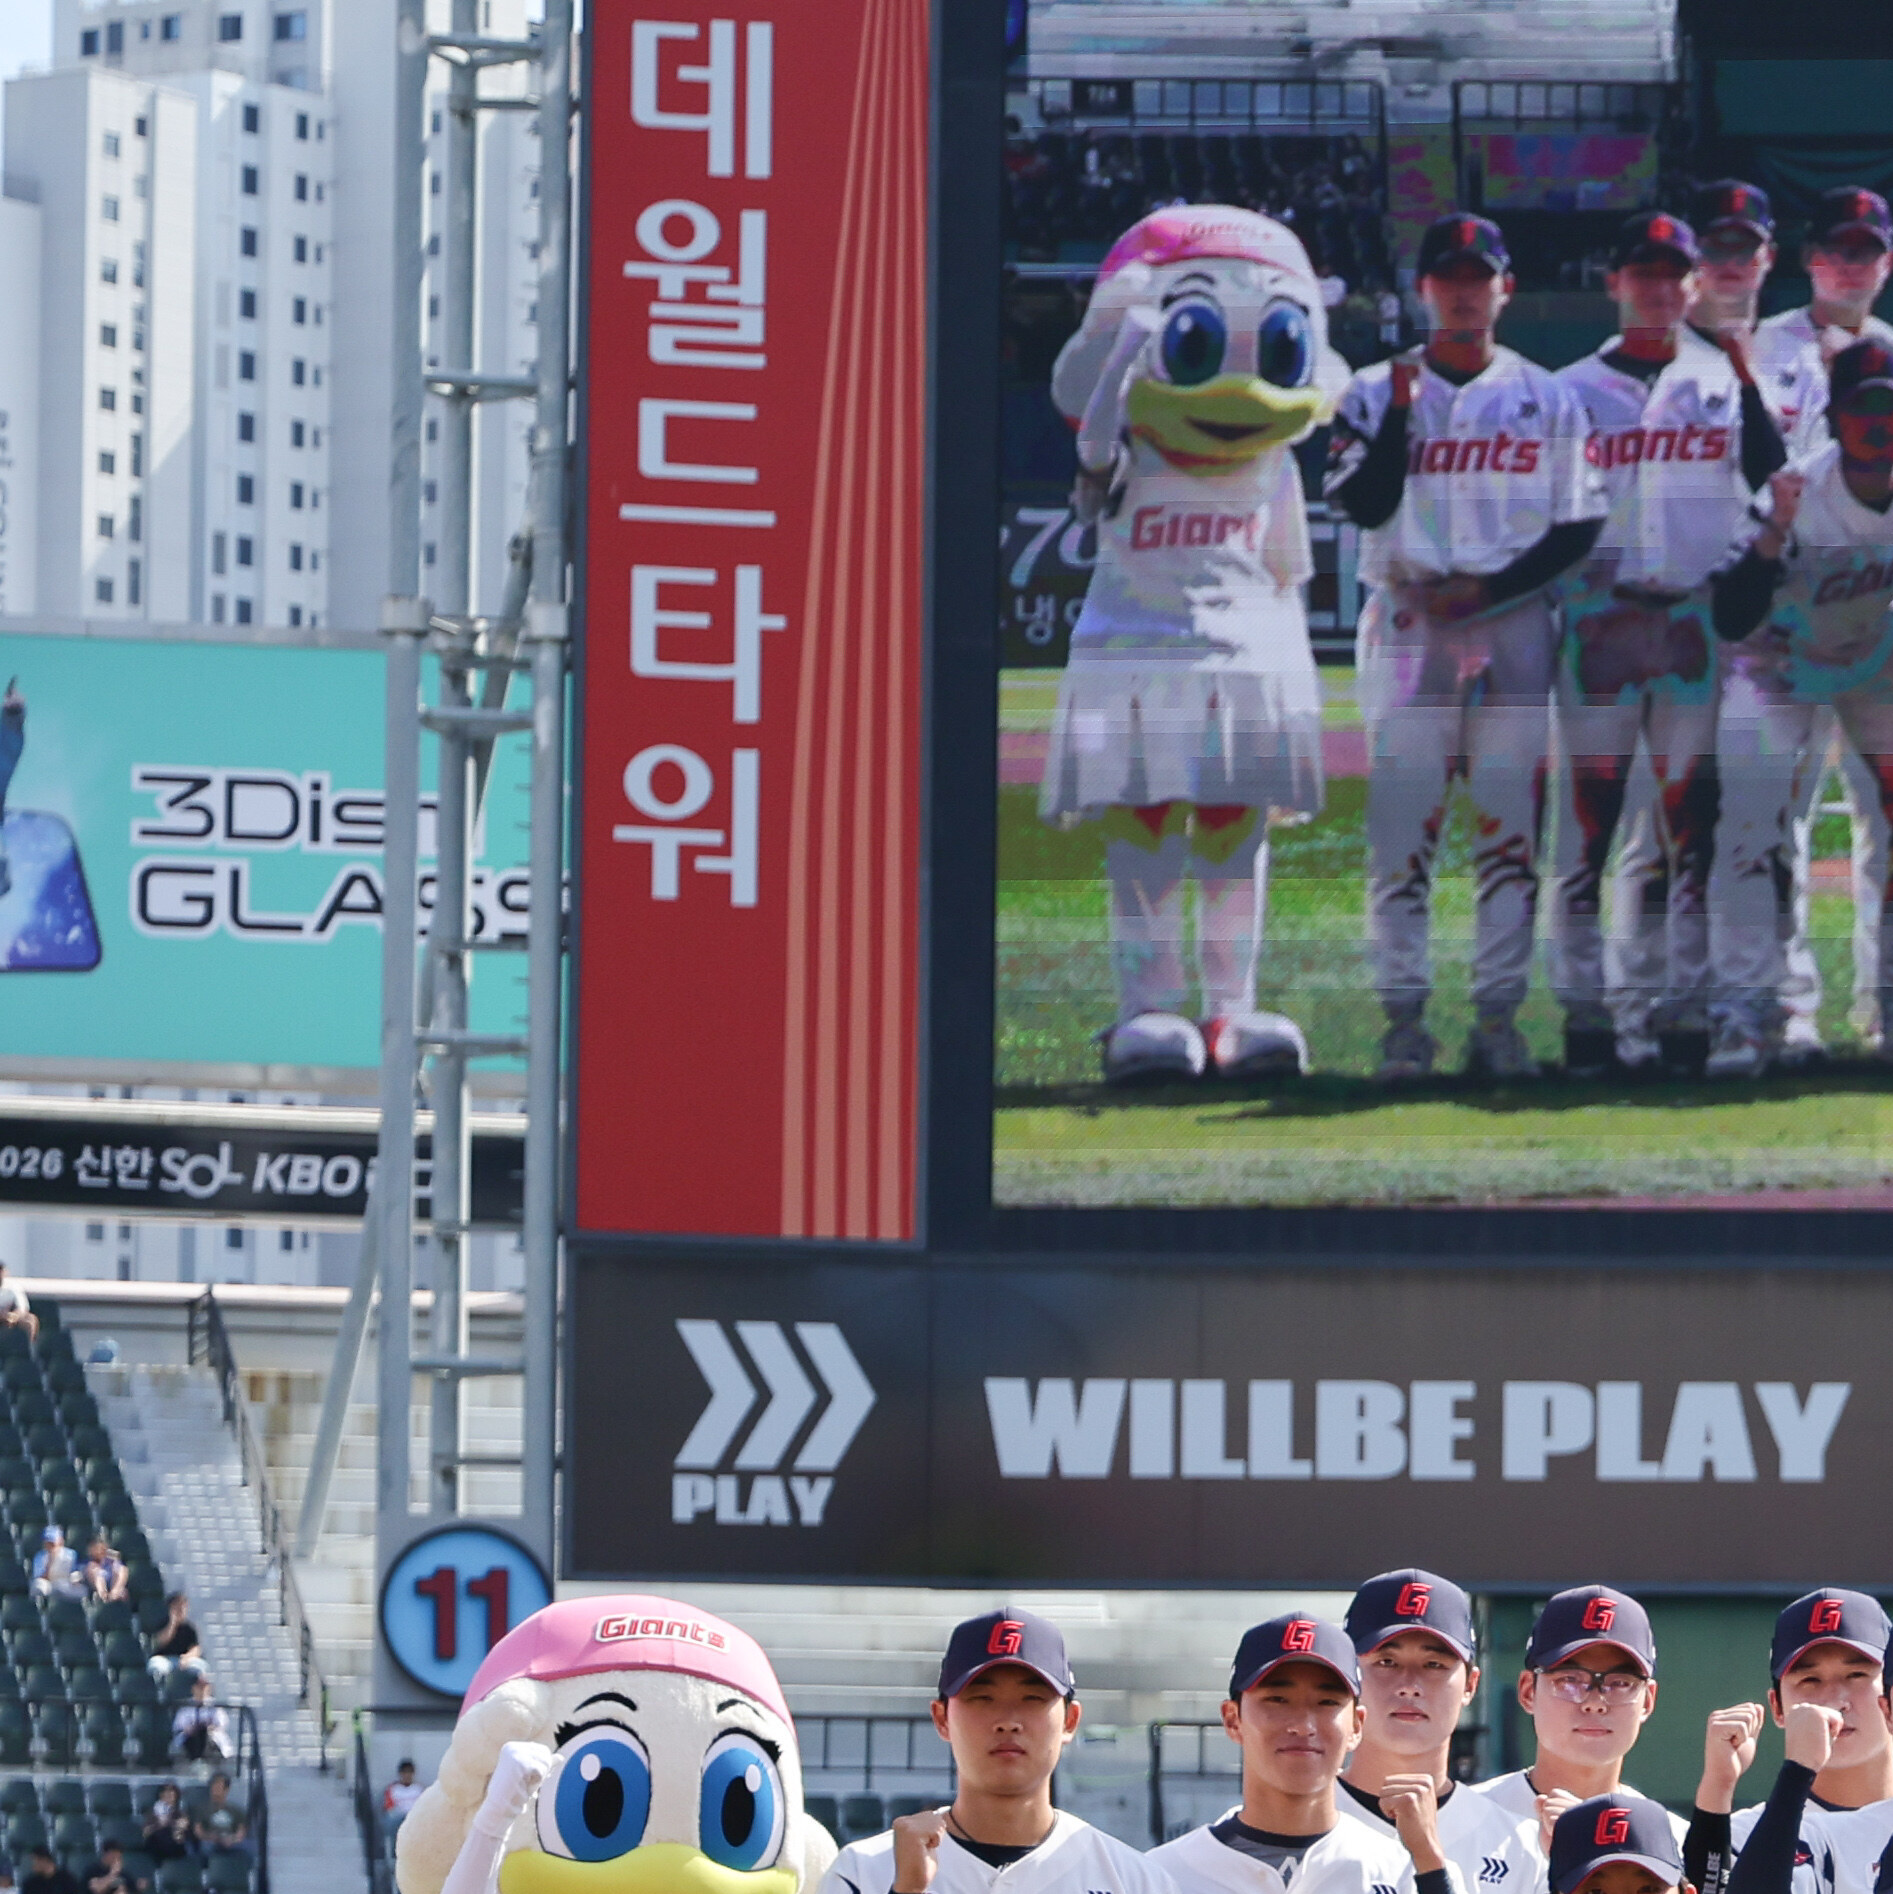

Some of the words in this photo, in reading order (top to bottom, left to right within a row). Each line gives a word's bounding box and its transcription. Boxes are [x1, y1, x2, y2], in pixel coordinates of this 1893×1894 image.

[1408, 428, 1541, 474] iants
[73, 1145, 154, 1189] 신한
[984, 1376, 1477, 1482] WILLBE
[1502, 1380, 1852, 1484] PLAY
[671, 1475, 834, 1527] PLAY
[414, 1565, 509, 1660] 11
[601, 1616, 728, 1650] Giants
